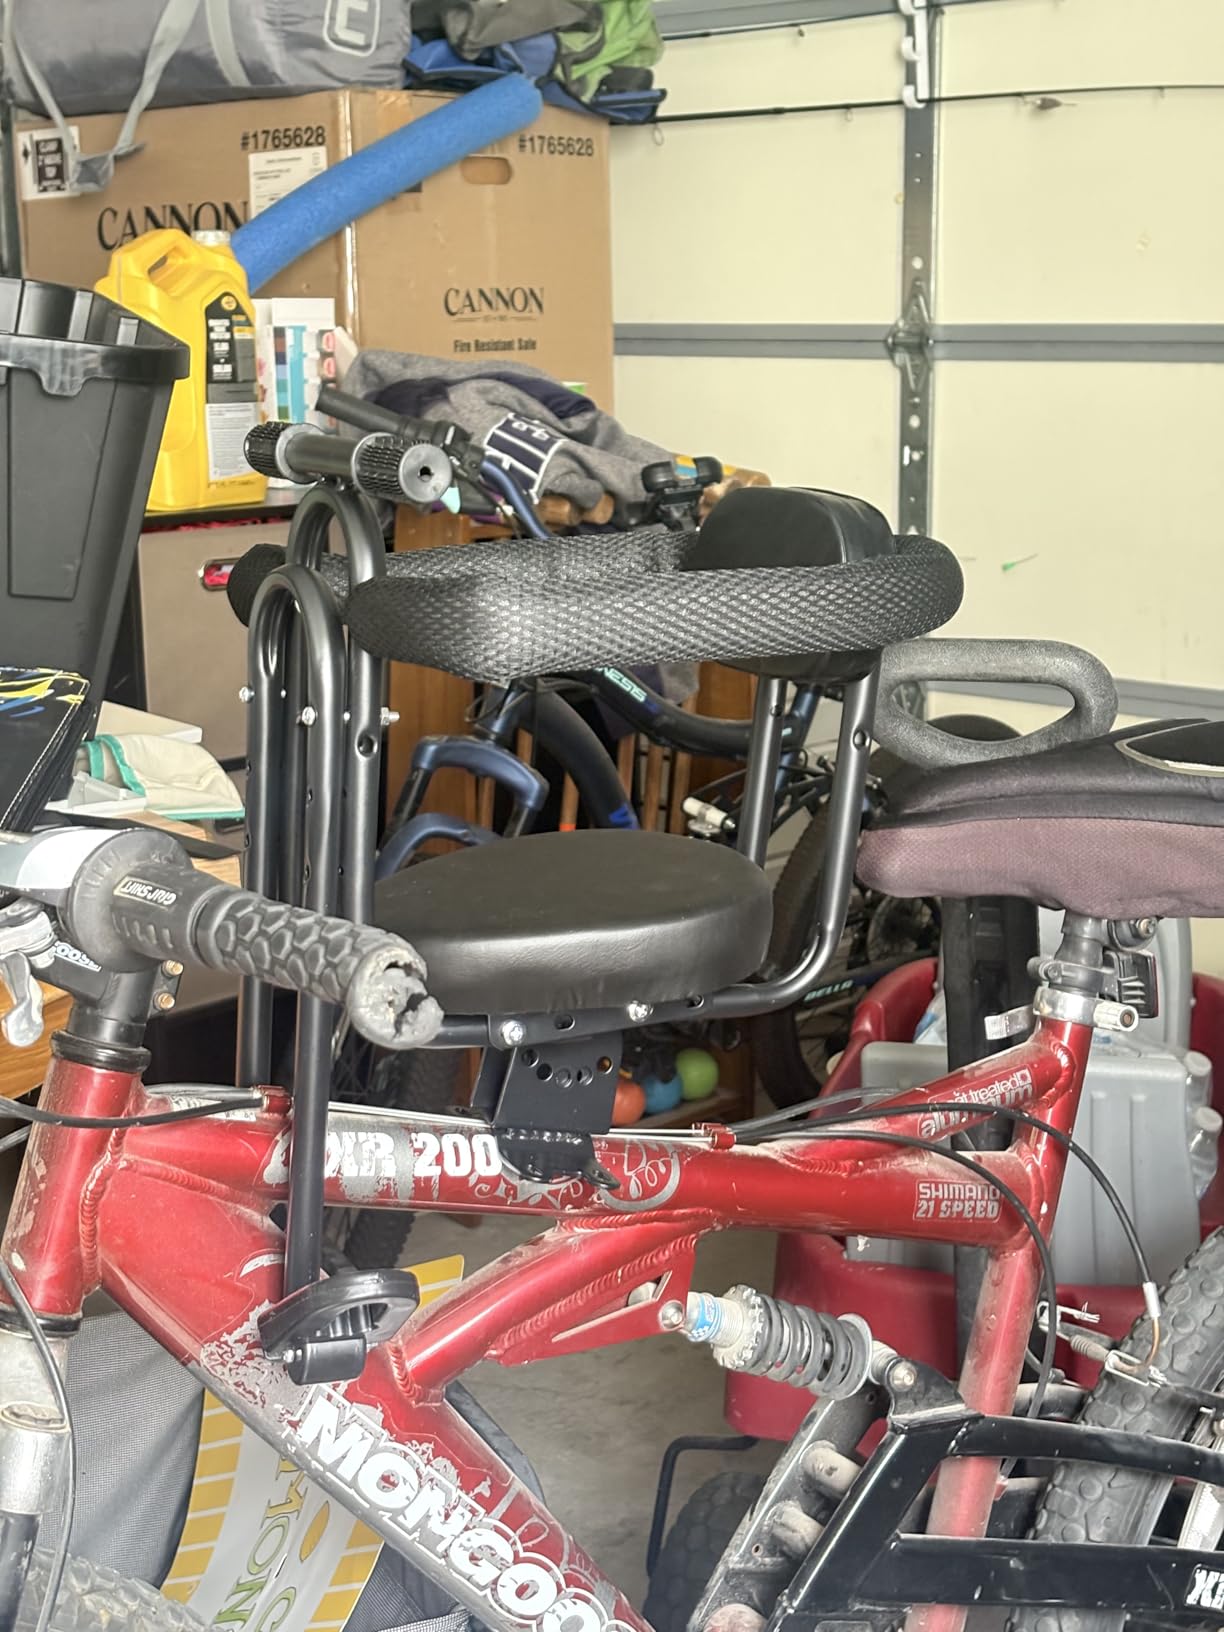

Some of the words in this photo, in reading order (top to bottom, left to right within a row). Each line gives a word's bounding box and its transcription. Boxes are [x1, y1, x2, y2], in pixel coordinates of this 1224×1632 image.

[241, 126, 326, 150] #1765628
[519, 135, 594, 157] #1765628
[97, 201, 248, 250] CANNON
[443, 286, 544, 316] CANNON
[969, 1072, 1022, 1102] treated
[412, 1132, 503, 1178] 200
[918, 1183, 1001, 1200] SHIMANO
[915, 1199, 936, 1219] 21
[938, 1199, 1000, 1219] SPEED
[288, 1386, 645, 1632] MONGOO
